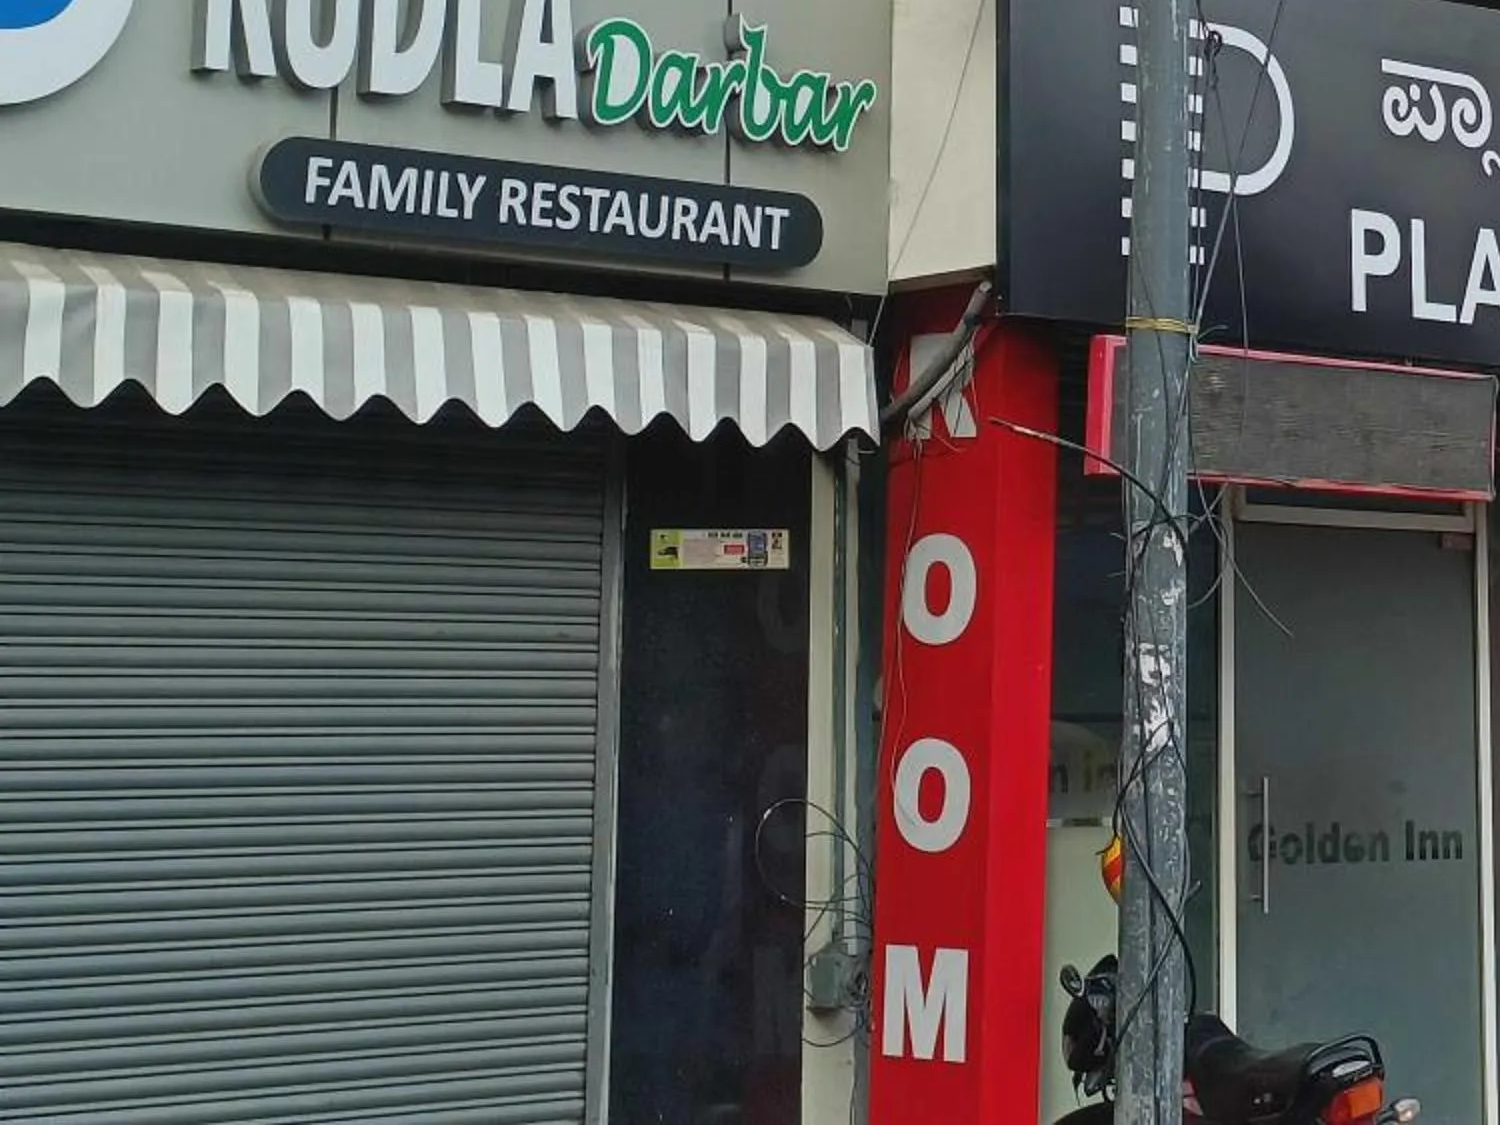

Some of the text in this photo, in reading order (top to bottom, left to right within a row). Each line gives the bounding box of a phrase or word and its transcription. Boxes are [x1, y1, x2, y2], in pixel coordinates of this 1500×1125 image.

[583, 15, 876, 153] Darbar
[305, 156, 790, 250] FAMILY RESTAURANT
[1248, 818, 1464, 866] Golden Inn
